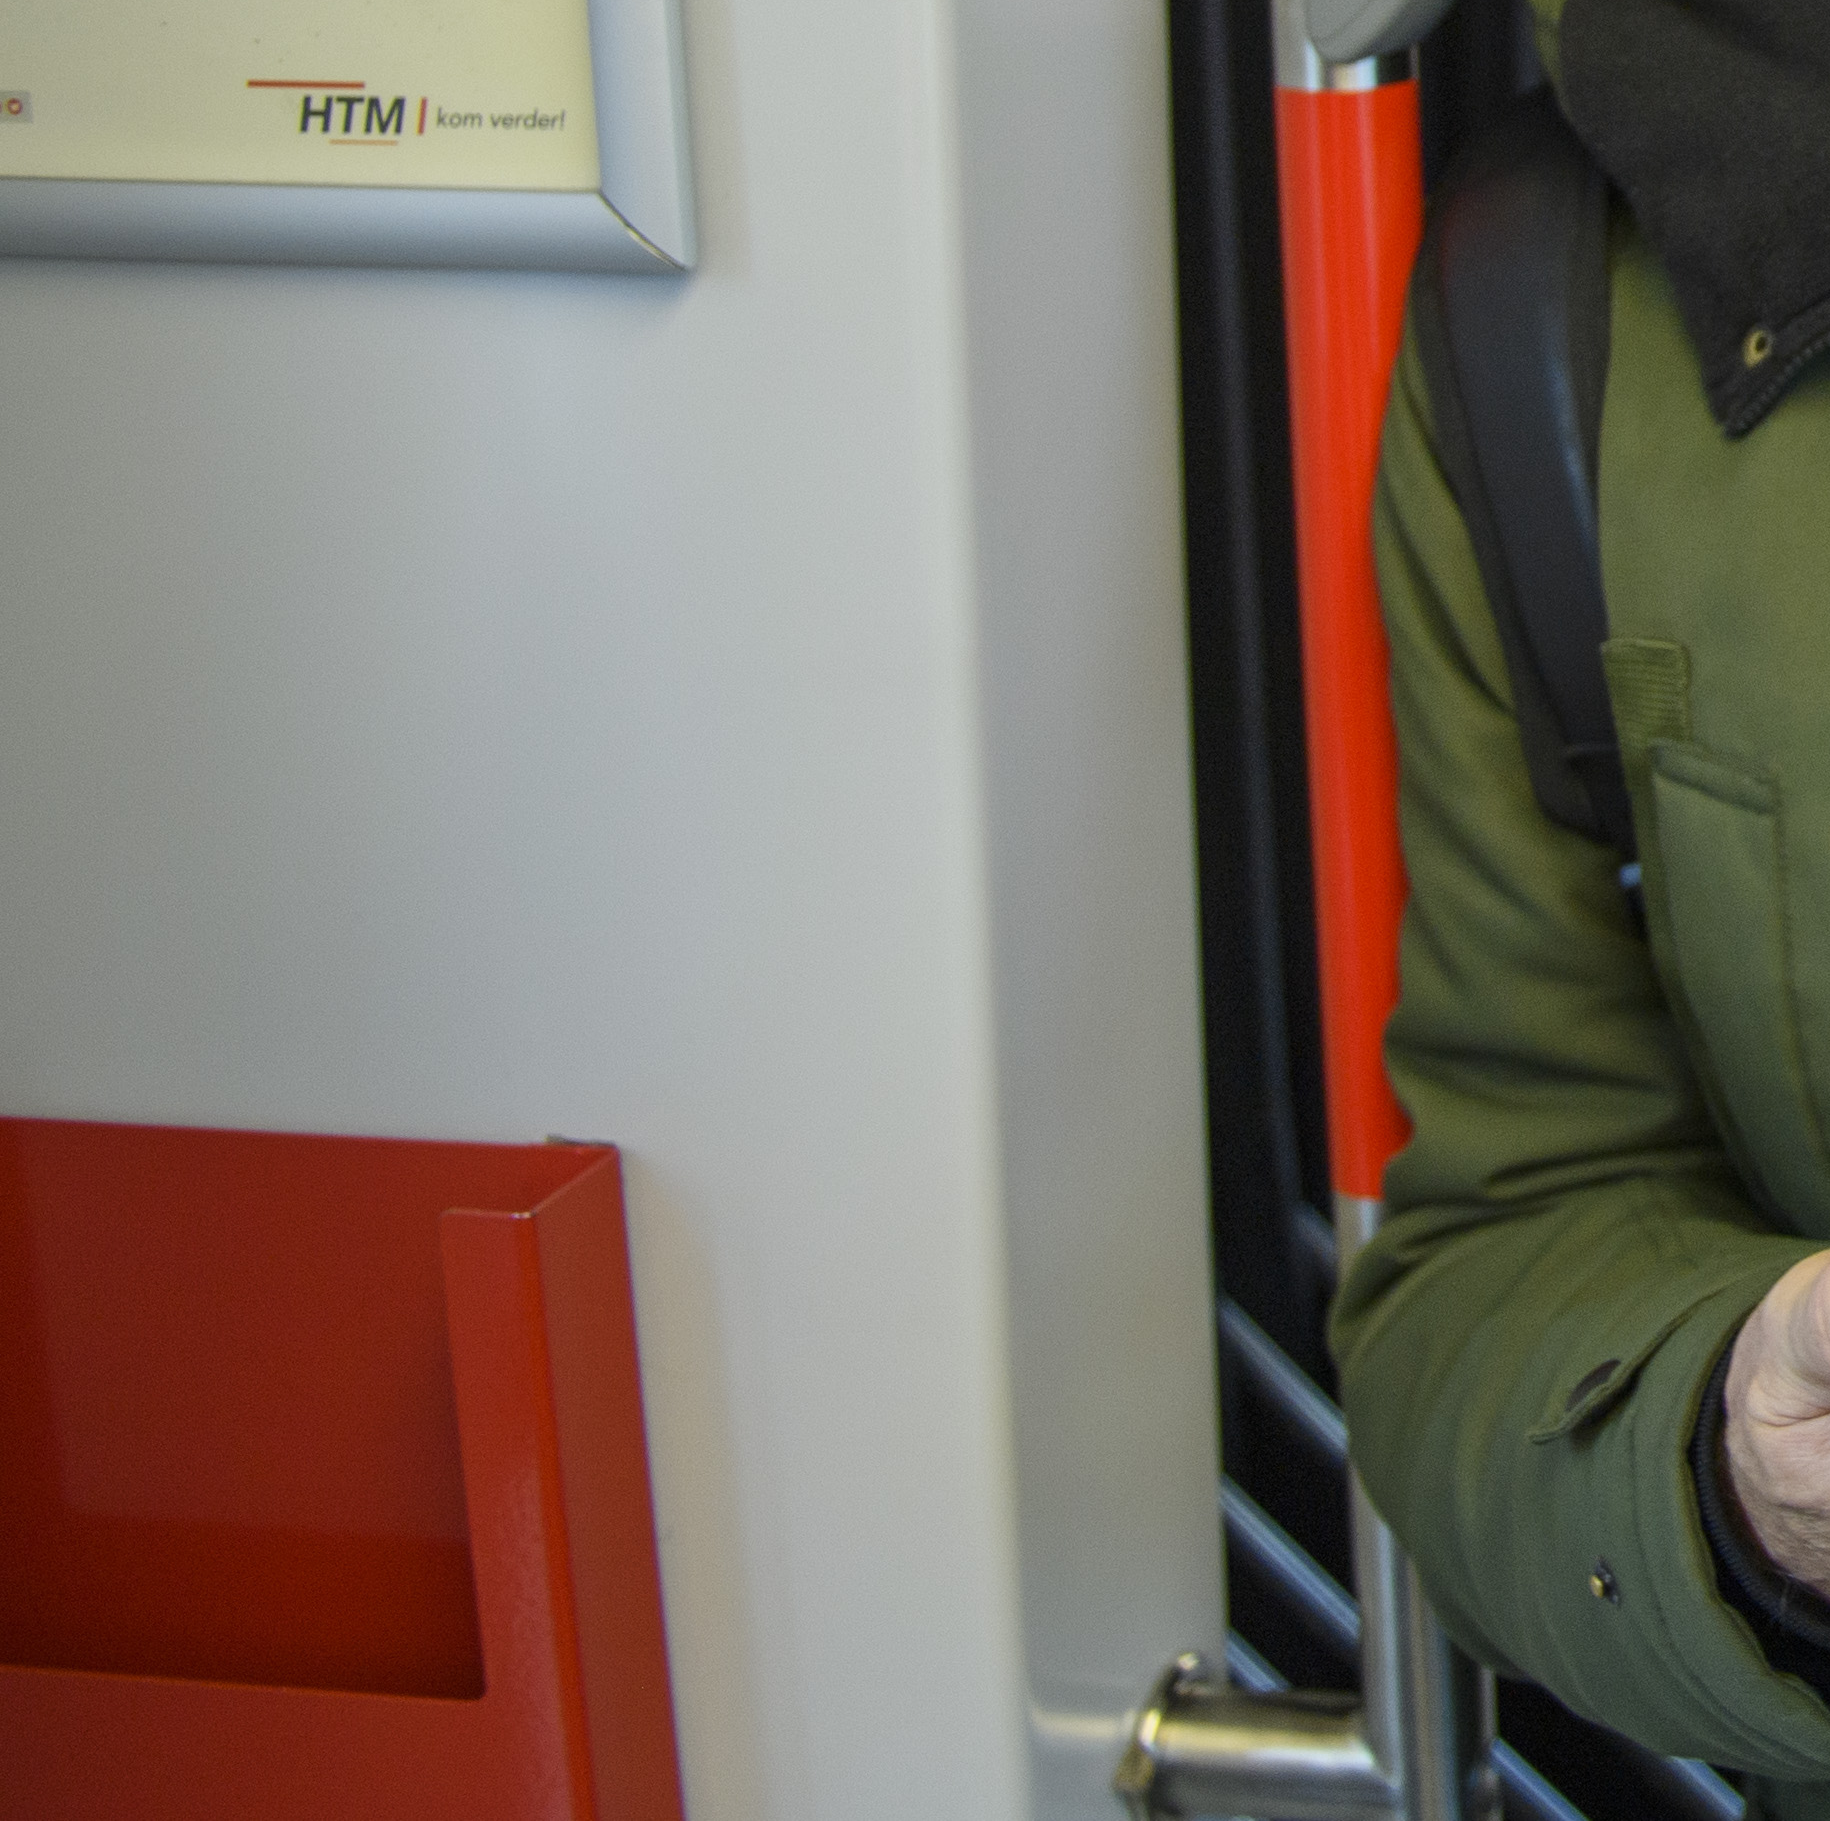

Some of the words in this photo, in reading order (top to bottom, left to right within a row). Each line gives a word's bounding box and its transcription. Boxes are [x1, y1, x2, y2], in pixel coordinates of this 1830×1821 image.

[299, 95, 405, 136] HTM
[436, 107, 483, 128] kom
[489, 108, 566, 132] verder!
